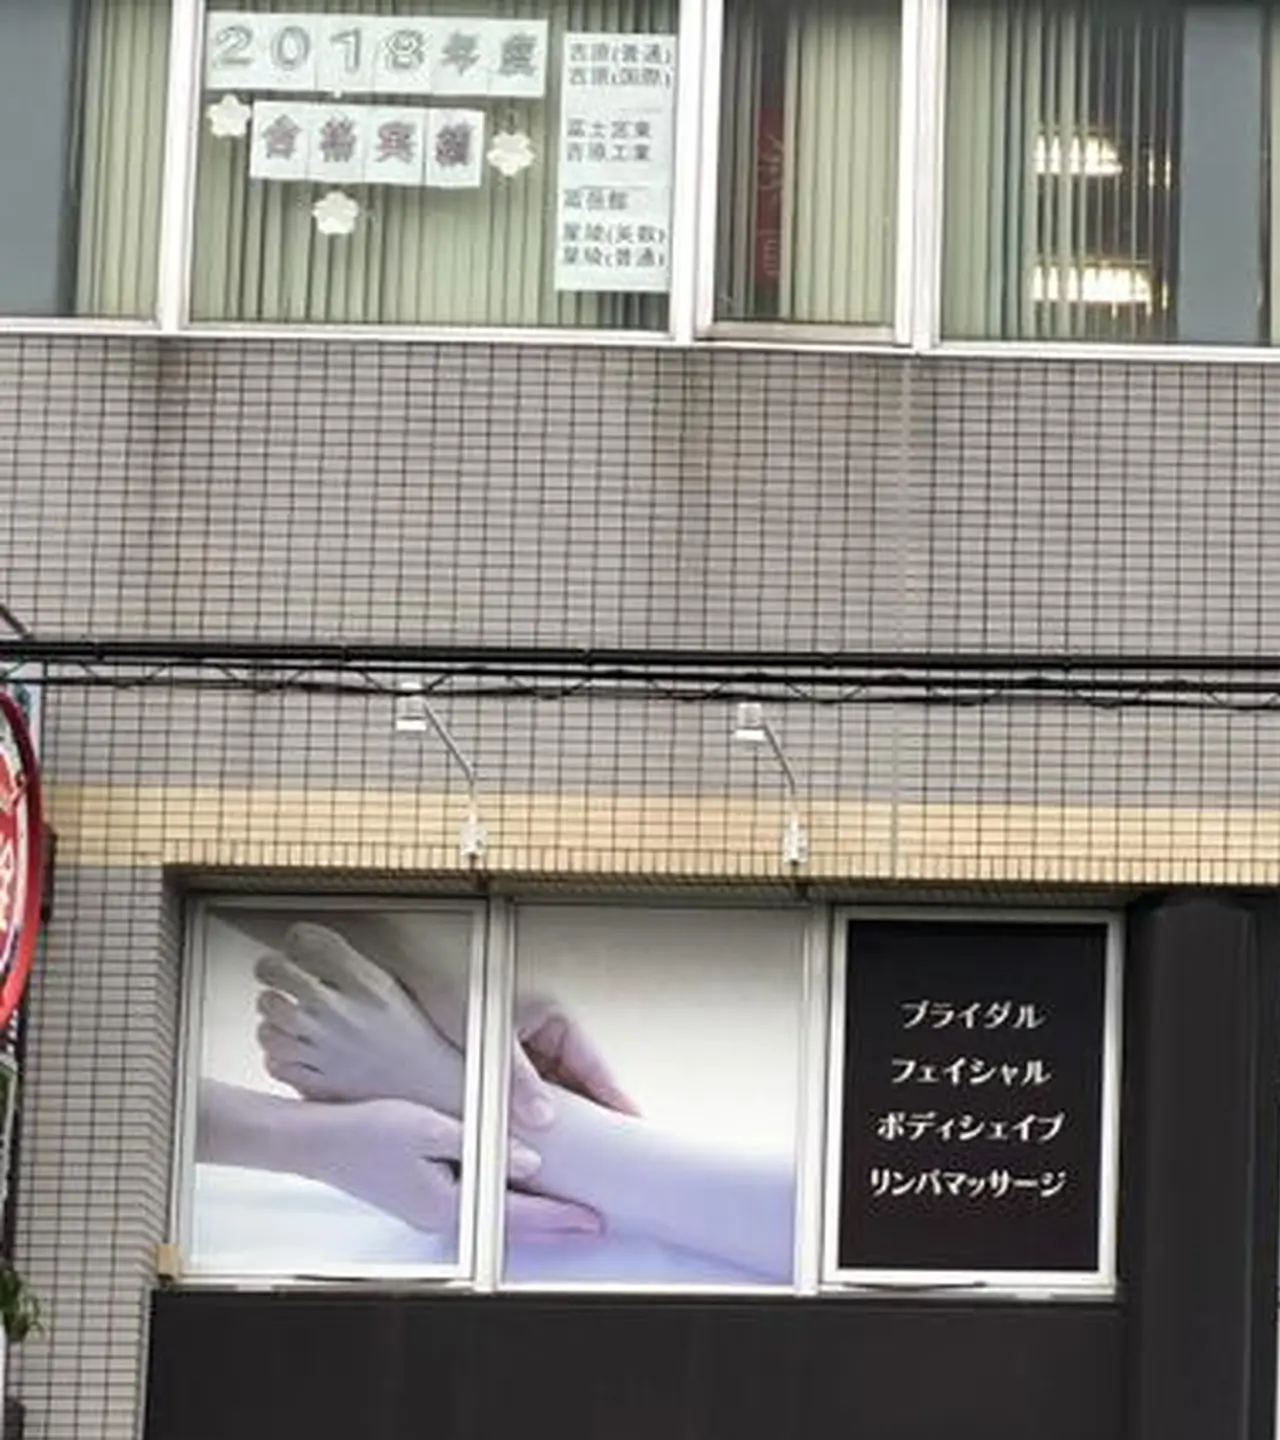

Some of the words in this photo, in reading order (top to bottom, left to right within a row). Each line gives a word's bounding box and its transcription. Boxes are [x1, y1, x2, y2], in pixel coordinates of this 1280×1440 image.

[260, 113, 475, 168] 合格実績
[902, 999, 1046, 1030] ブライダル
[891, 1056, 1053, 1087] フェイシャル
[876, 1111, 1067, 1142] ボディシェイプ
[869, 1168, 1069, 1198] リンパマッサージ
